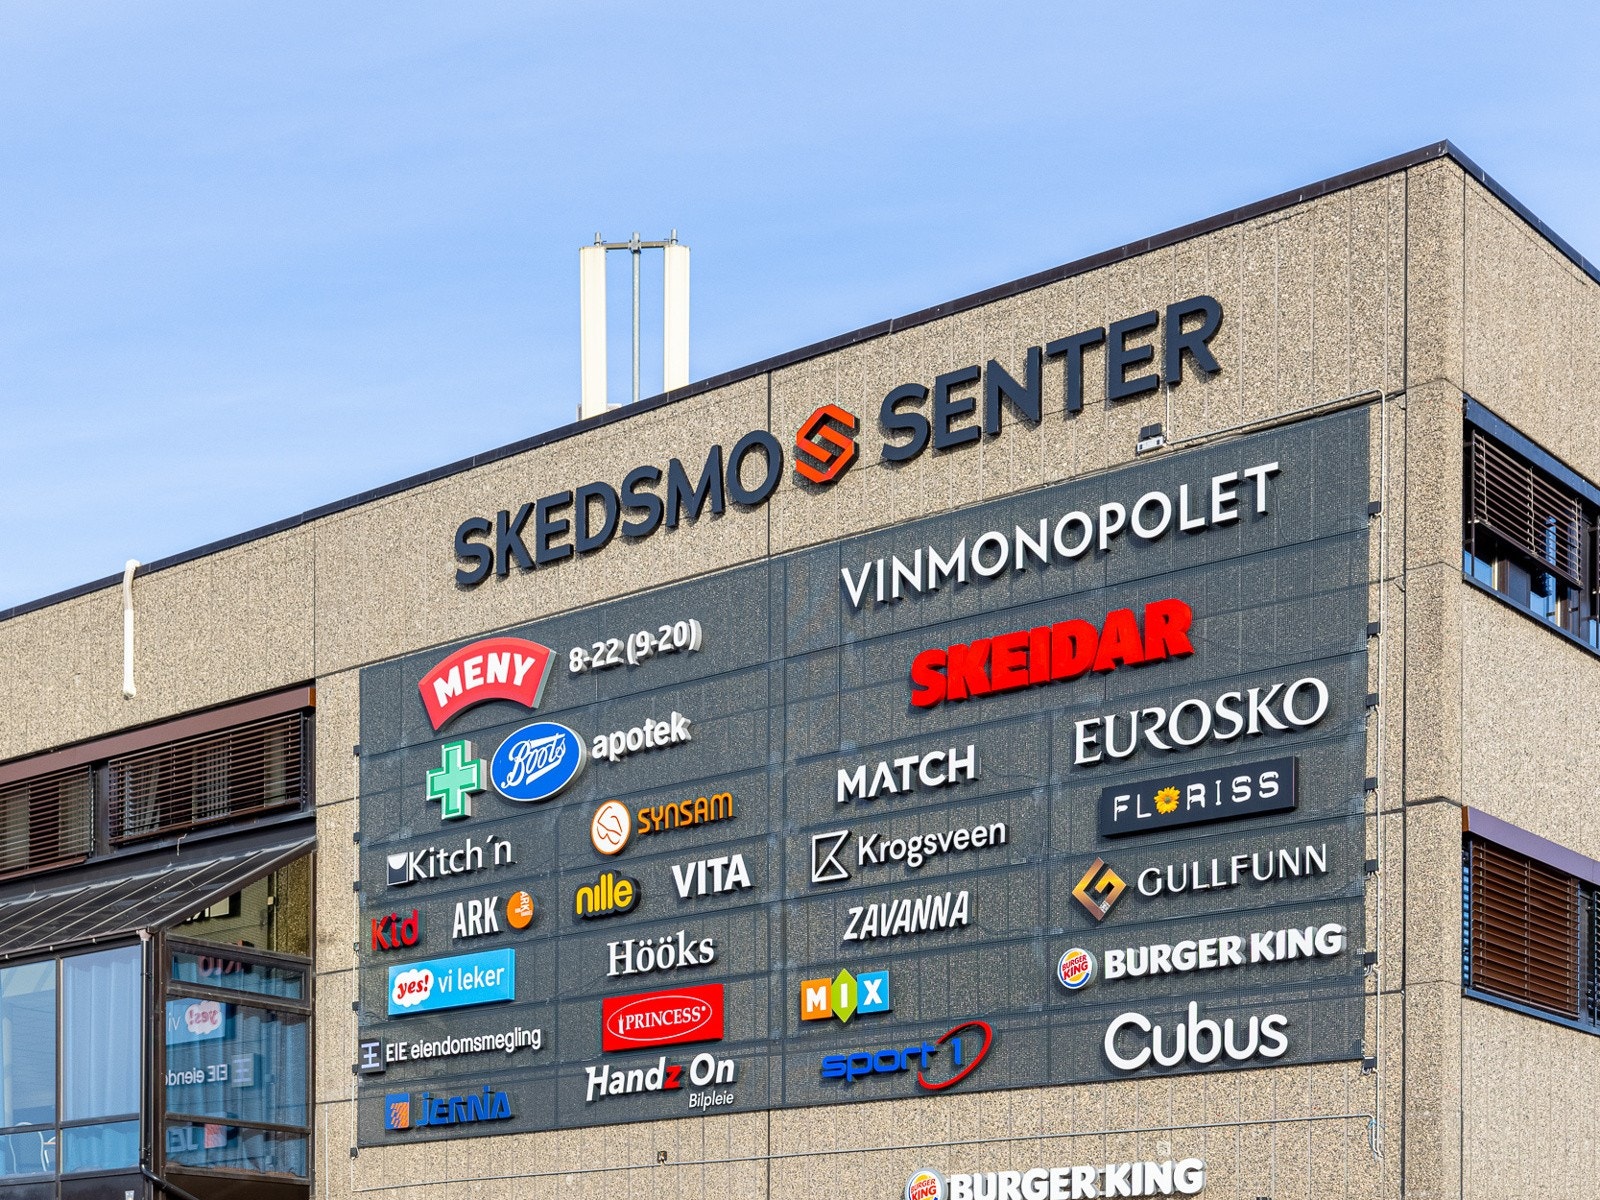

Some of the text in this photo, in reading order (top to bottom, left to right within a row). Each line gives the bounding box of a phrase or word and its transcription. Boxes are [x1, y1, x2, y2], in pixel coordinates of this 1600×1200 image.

[455, 429, 784, 585] SKEDSMO
[880, 294, 1224, 462] SENTER
[841, 461, 1281, 608] VINMONOPOLET
[569, 619, 702, 673] 8-22 (9-20)
[911, 598, 1195, 708] SKEIDAR
[433, 651, 536, 708] MENY
[592, 711, 691, 762] apotek
[1074, 677, 1329, 765] EUROSKO
[501, 733, 567, 789] Boots
[837, 745, 977, 802] MATCH
[858, 822, 1007, 868] Krogsveen
[672, 854, 752, 899] VITA
[1138, 844, 1328, 896] GULLFUNN
[452, 896, 499, 939] ARK
[576, 872, 633, 917] nille
[843, 890, 970, 941] ZAVANNA
[607, 931, 715, 976] Hööks
[1062, 953, 1088, 972] BURGER
[1063, 961, 1089, 980] KING
[1105, 923, 1345, 979] BURGER KING
[397, 964, 505, 1000] yes! vi leker
[807, 977, 883, 1013] MIX
[625, 1006, 702, 1031] PRINCESS
[1105, 1001, 1289, 1070] Cubus
[386, 1027, 541, 1062] EIE eiendomsmegling
[585, 1053, 735, 1101] Handz On
[689, 1090, 735, 1109] Bilpleie
[911, 1178, 937, 1194] BURGER
[1105, 1158, 1205, 1197] KING
